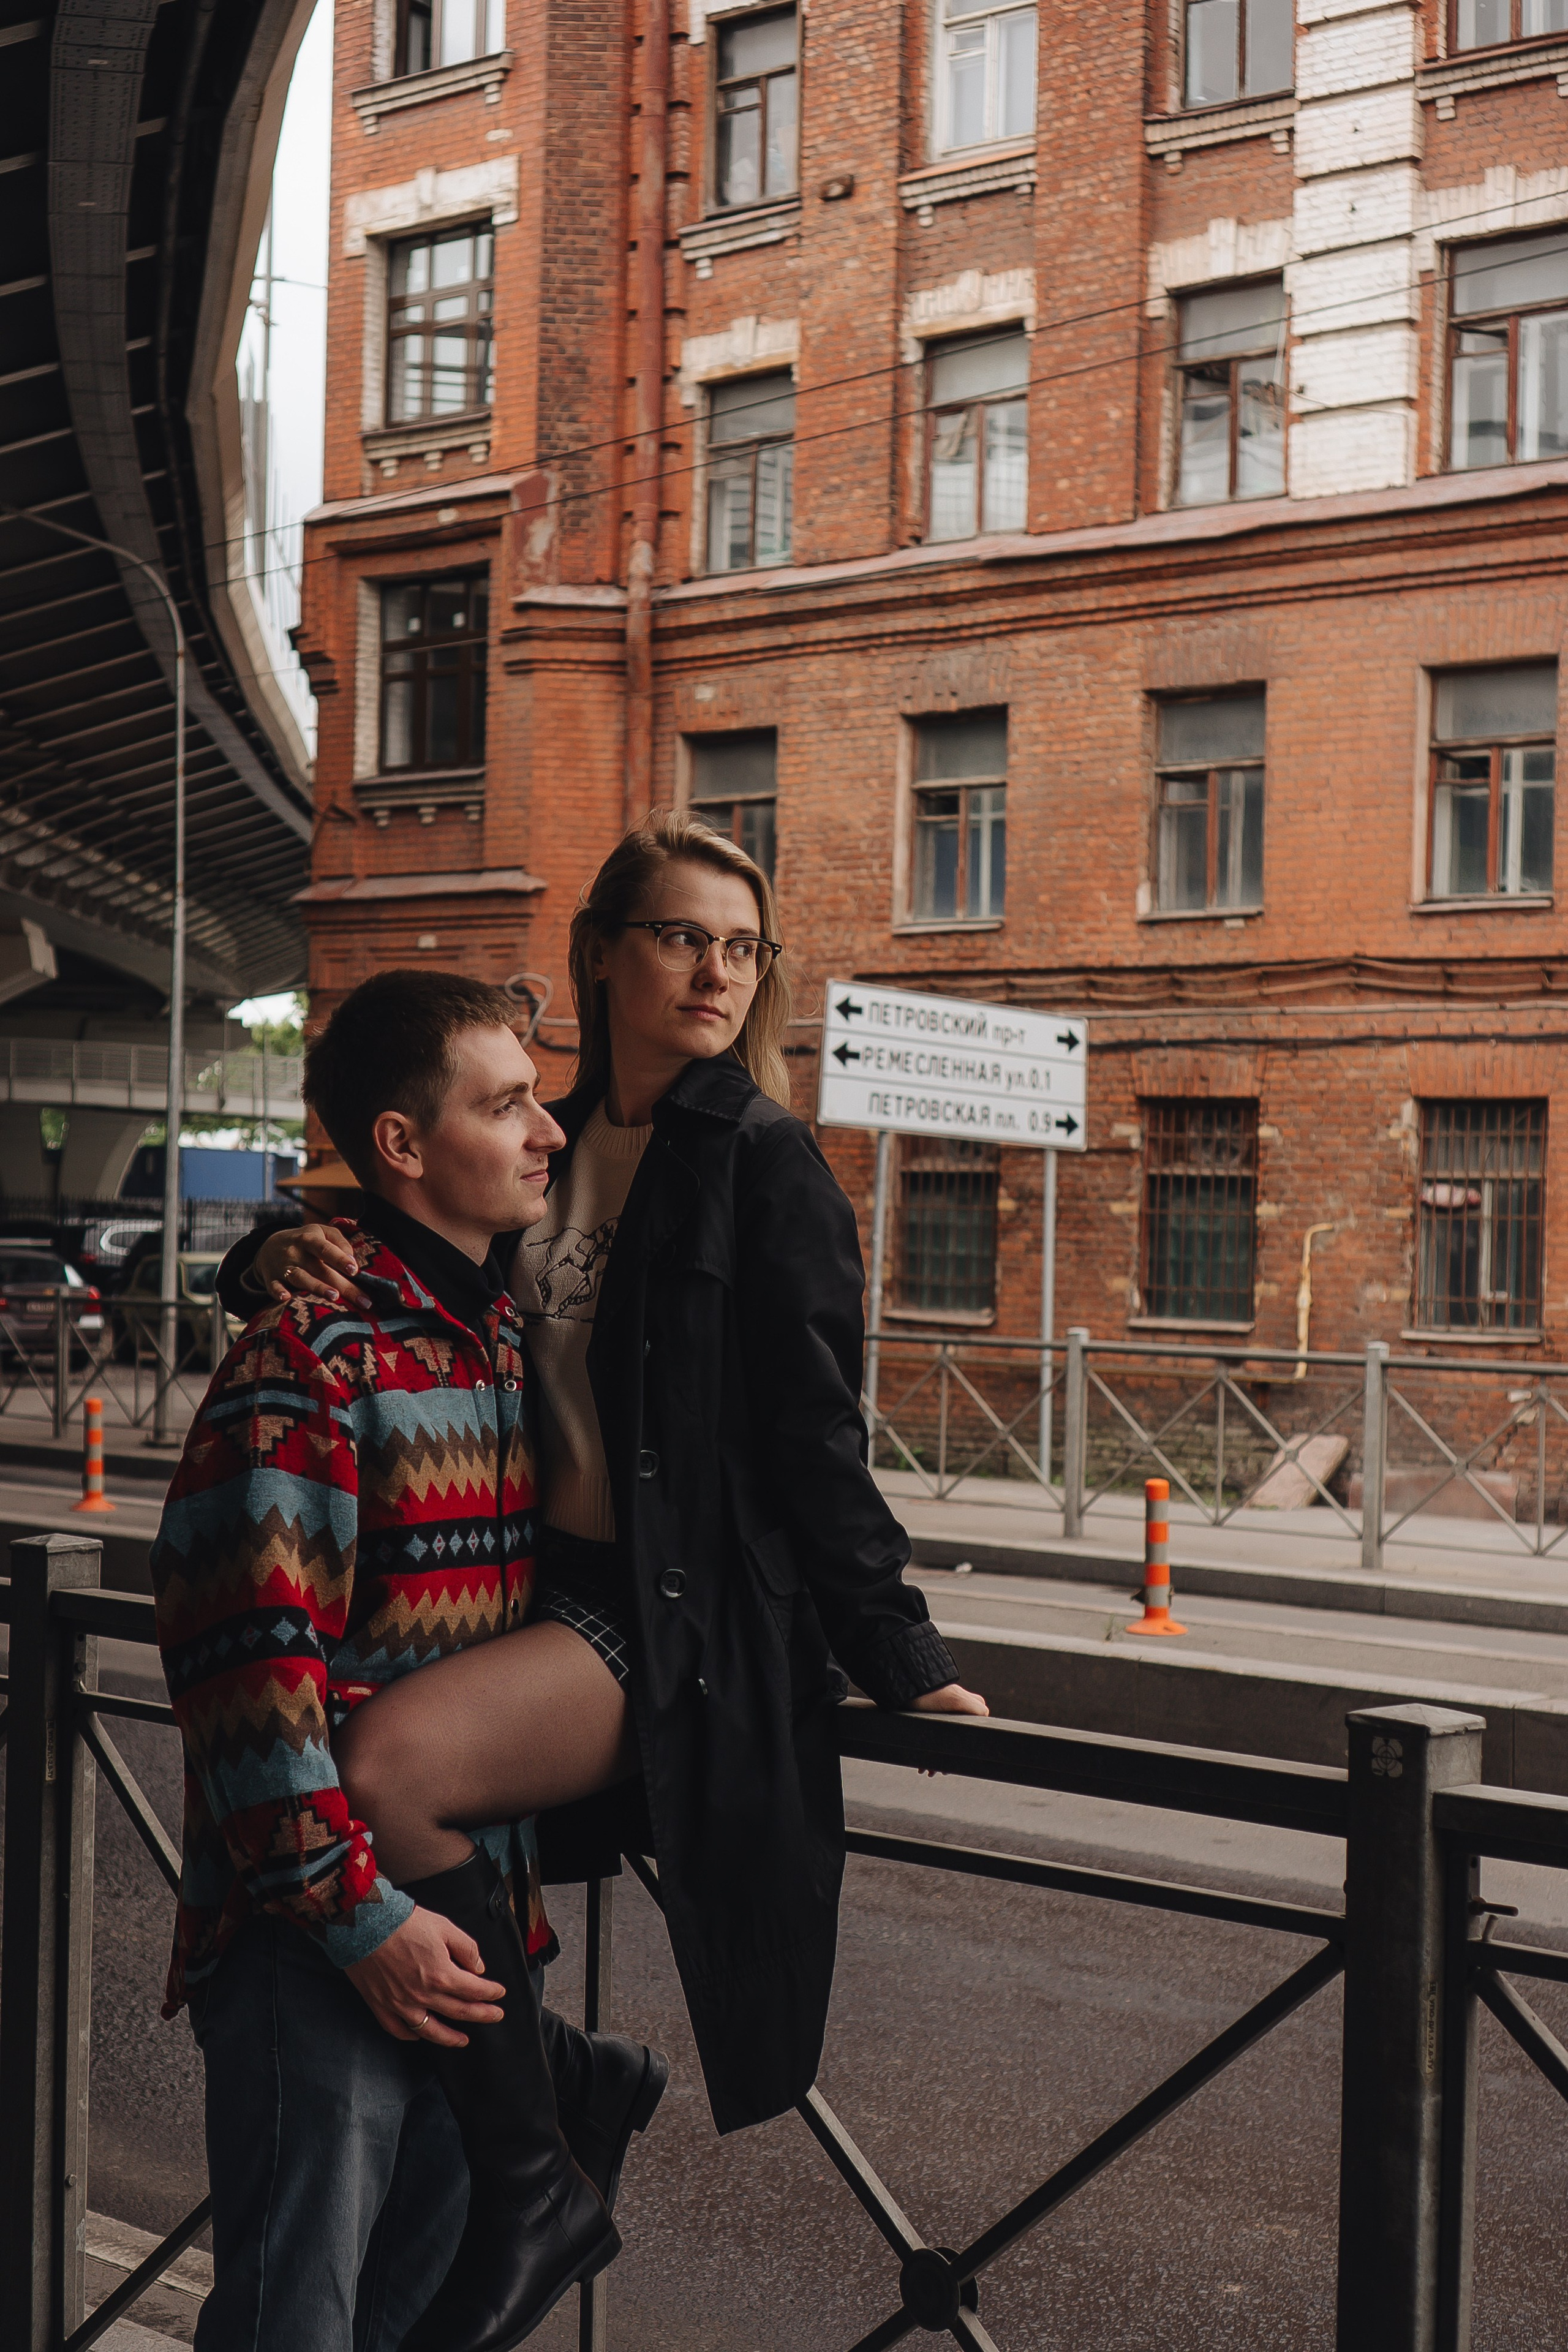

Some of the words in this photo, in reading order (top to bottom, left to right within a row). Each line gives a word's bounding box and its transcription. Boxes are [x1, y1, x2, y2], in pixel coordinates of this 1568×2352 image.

[869, 1001, 987, 1039] ПЕТРОВСКИЙ
[992, 1025, 1026, 1047] пр-т
[861, 1045, 1001, 1084] РЕМЕСЛЕННАЯ
[869, 1092, 990, 1127] ПЕТРОВСКАЯ
[1028, 1110, 1052, 1133] 0.9
